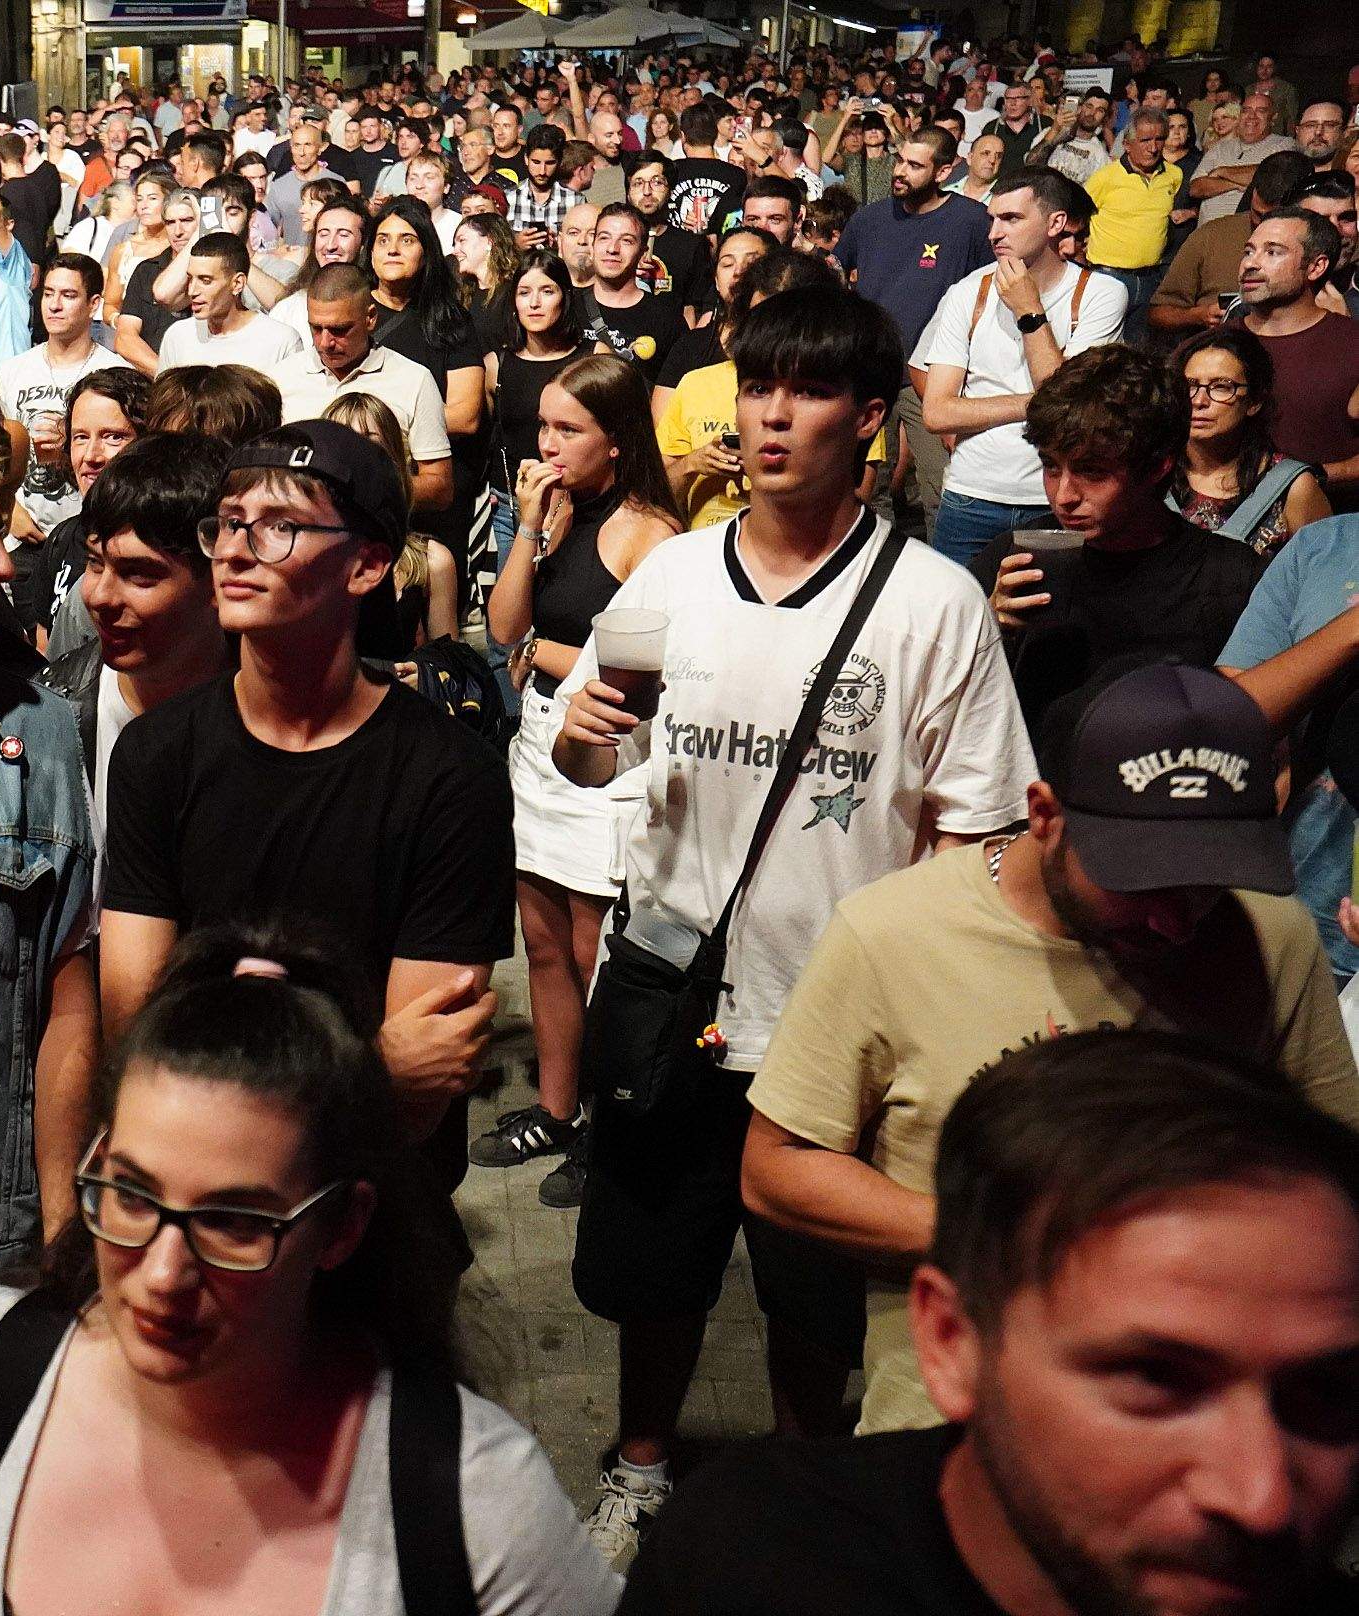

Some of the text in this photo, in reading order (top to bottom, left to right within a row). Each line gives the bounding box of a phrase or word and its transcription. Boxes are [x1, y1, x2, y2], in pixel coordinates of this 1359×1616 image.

[16, 385, 64, 412] DESAK
[664, 713, 725, 760] raw
[727, 720, 790, 769] Hat
